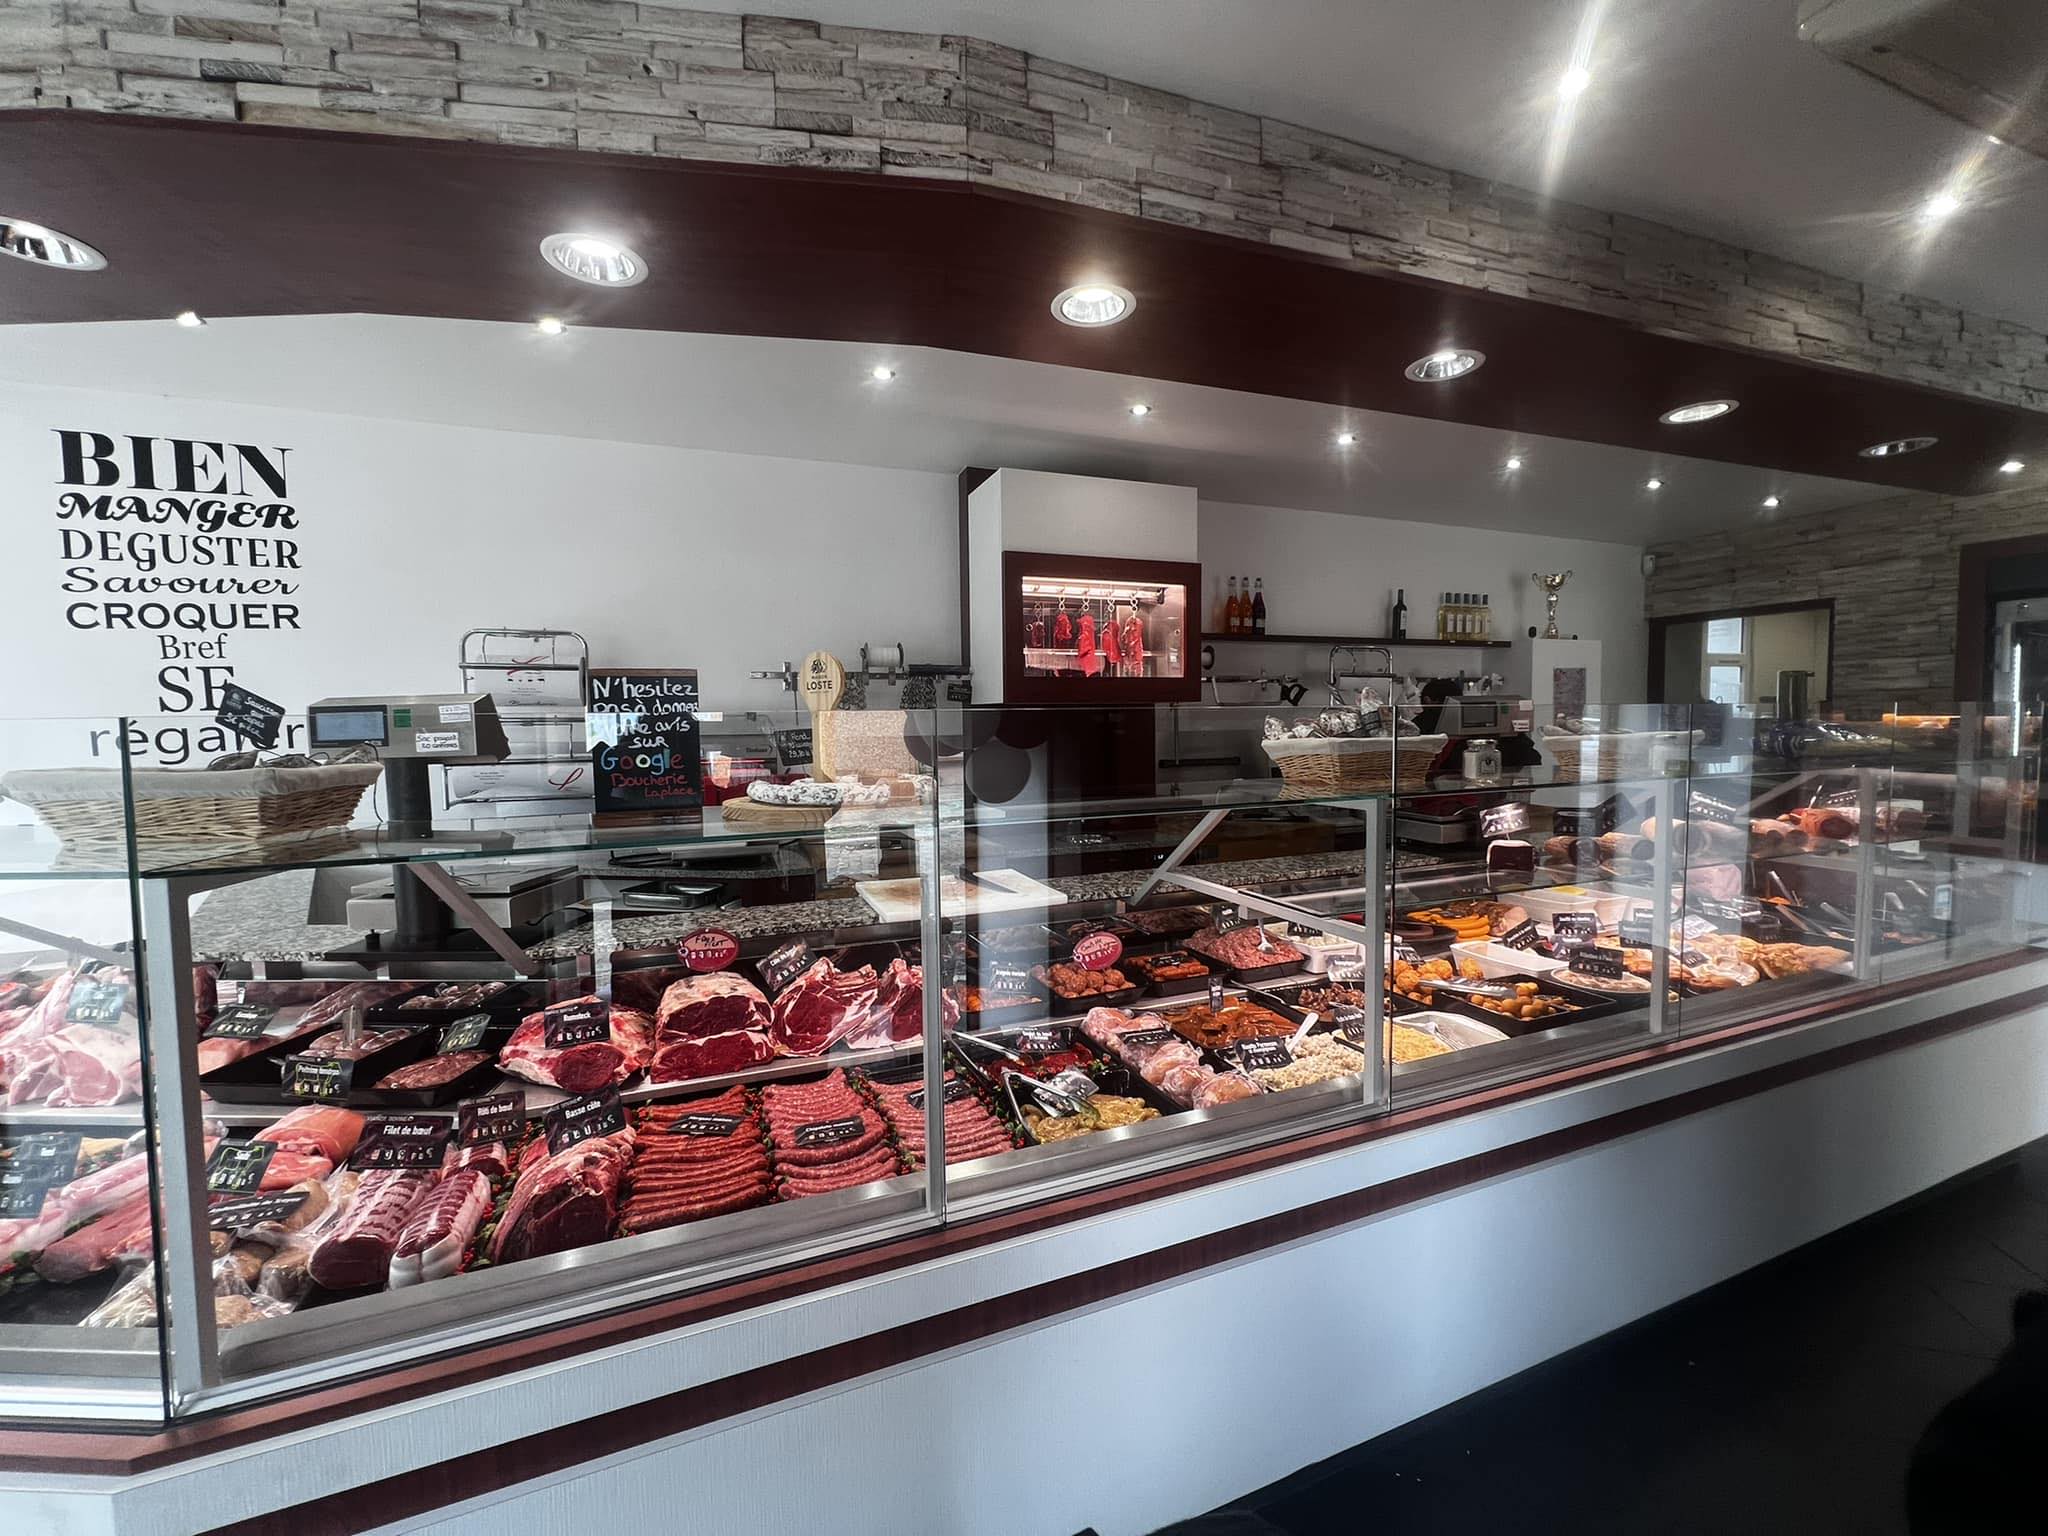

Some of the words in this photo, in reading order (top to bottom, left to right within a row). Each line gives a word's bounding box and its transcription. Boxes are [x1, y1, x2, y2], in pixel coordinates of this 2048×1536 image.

[51, 428, 294, 499] BIEN
[56, 492, 299, 533] MANGER
[59, 528, 303, 571] DEGUSTER
[61, 566, 300, 595] Savourer
[66, 602, 302, 632] CROQUER
[157, 633, 228, 660] Bref
[806, 680, 833, 691] LOSTE
[654, 716, 692, 732] avis
[600, 746, 685, 775] Google
[610, 772, 689, 787] Boucherie
[564, 1105, 586, 1119] Basse
[383, 1125, 401, 1136] Filet
[401, 1125, 411, 1136] de
[411, 1125, 434, 1136] bœuf
